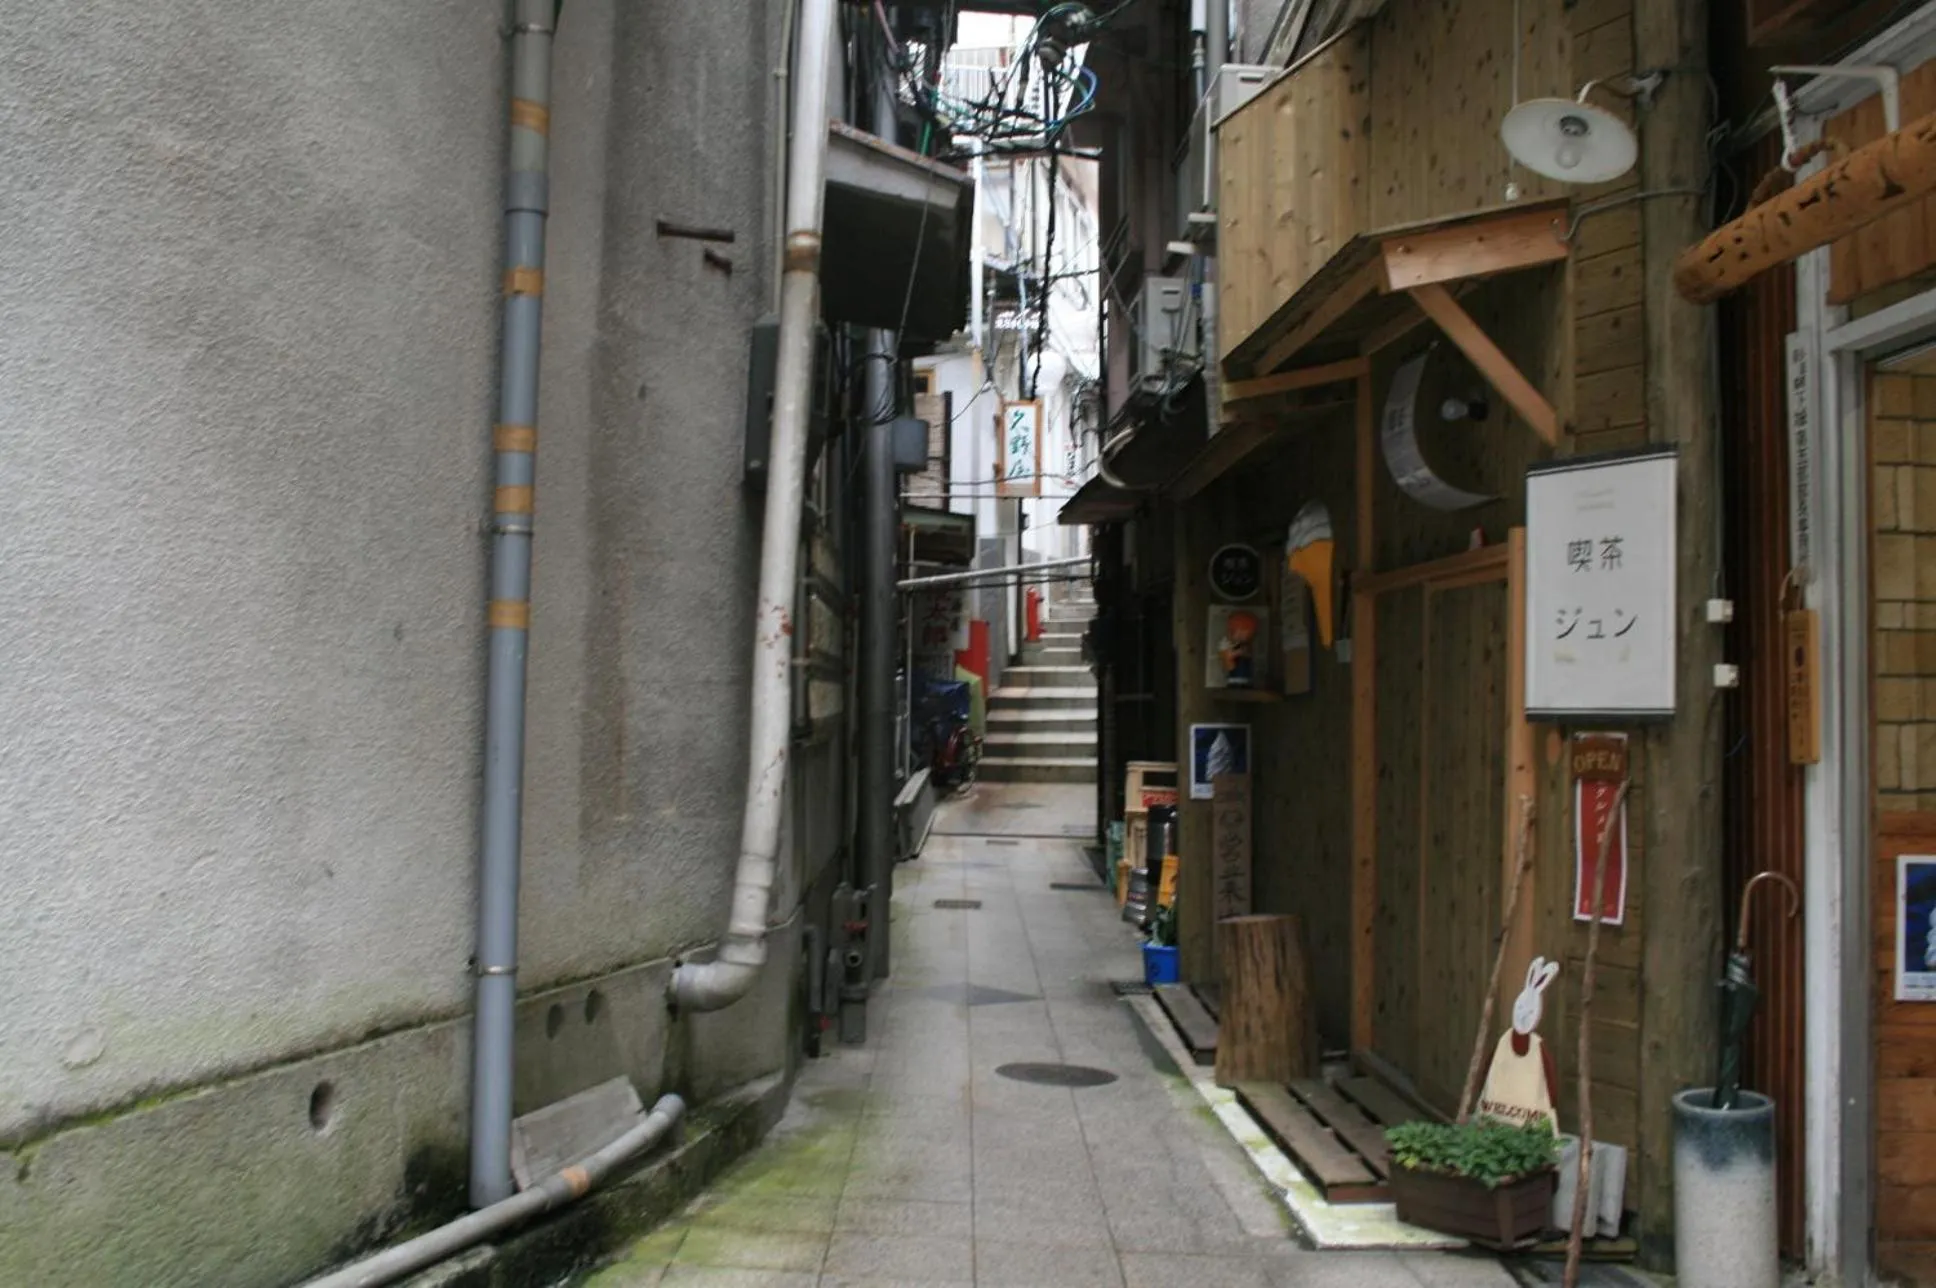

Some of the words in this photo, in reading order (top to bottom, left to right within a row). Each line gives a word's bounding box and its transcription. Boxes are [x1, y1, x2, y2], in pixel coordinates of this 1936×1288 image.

[1566, 535, 1625, 574] 喫茶
[1555, 606, 1639, 641] ジュン
[1573, 750, 1622, 773] OPEN
